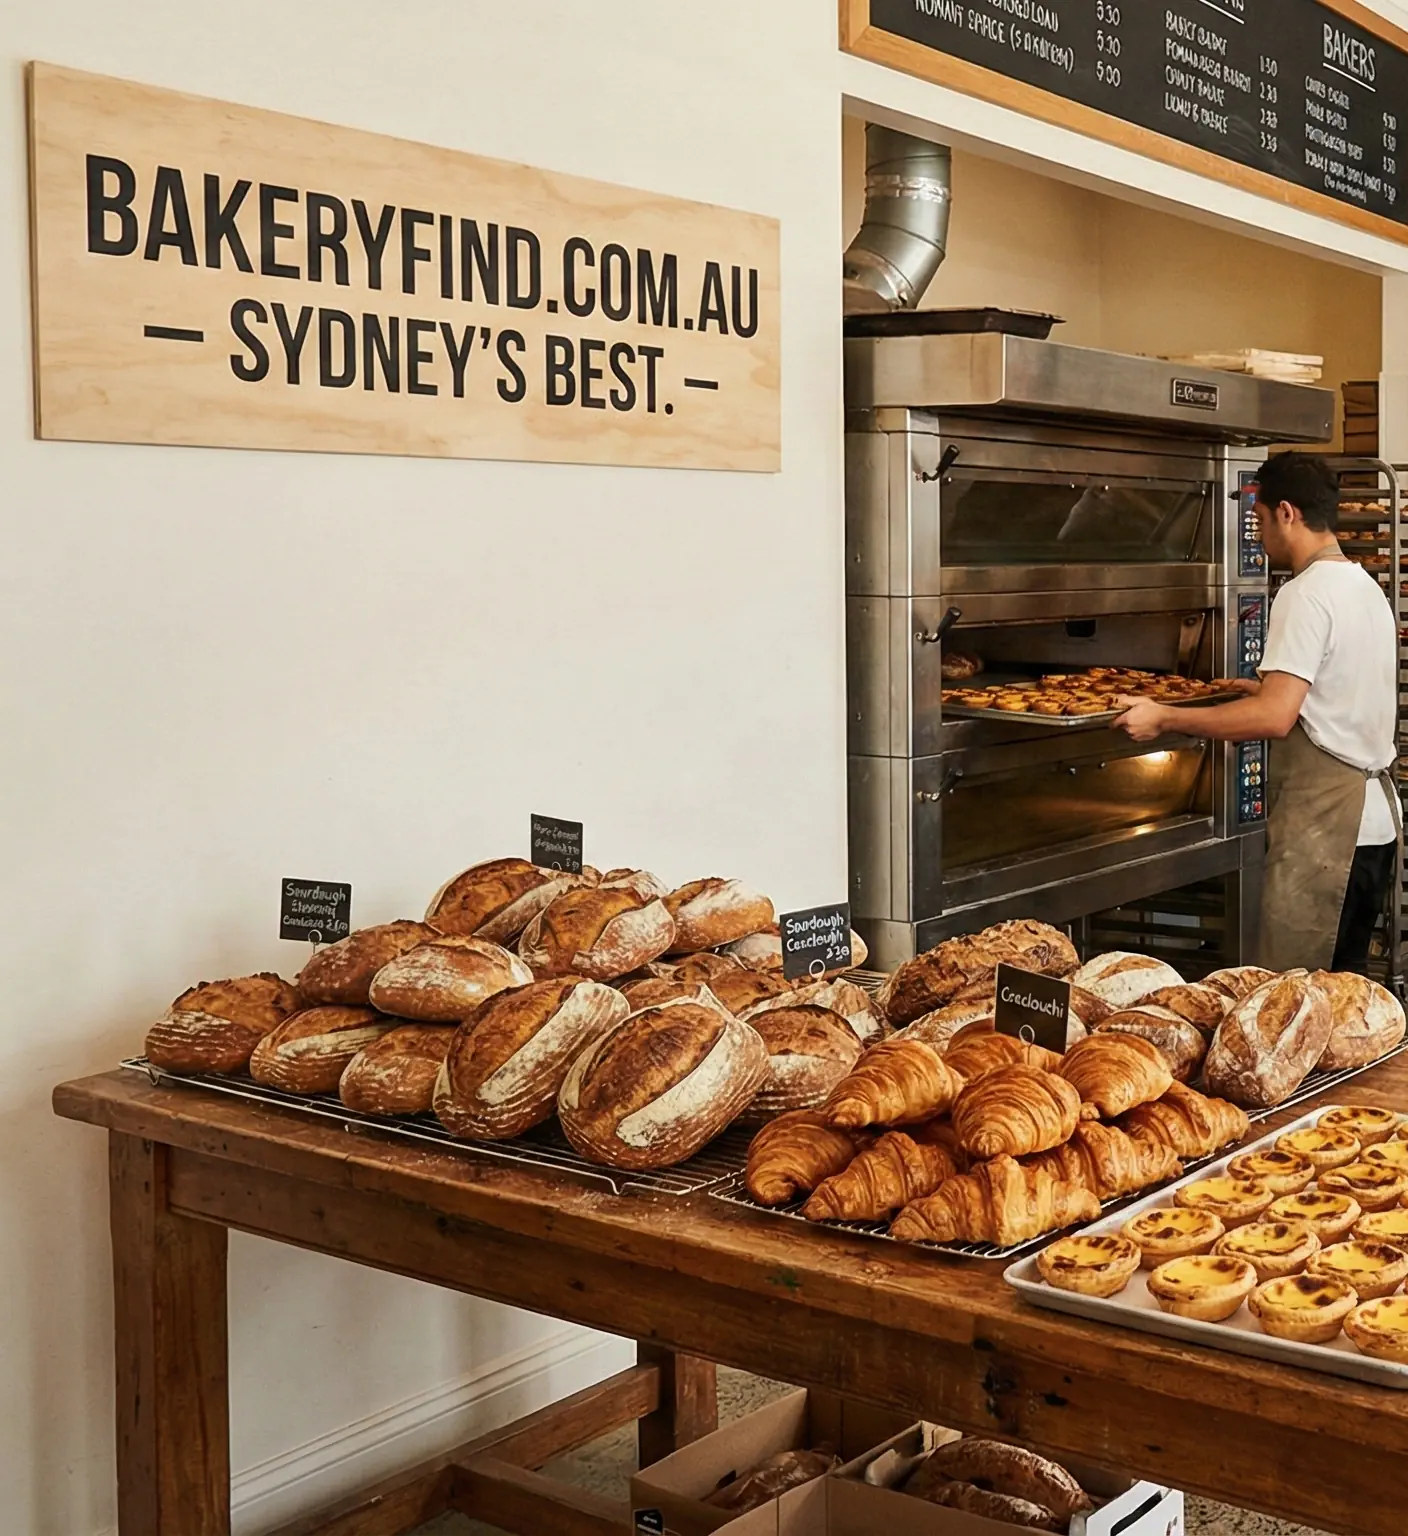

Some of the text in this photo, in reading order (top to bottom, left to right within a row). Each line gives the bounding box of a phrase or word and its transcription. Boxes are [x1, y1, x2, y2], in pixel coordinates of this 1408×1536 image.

[1323, 23, 1376, 81] BAKERS
[85, 153, 759, 339] BAKERYFIND.COM.AU
[230, 298, 675, 416] SYDNEY'S BEST.
